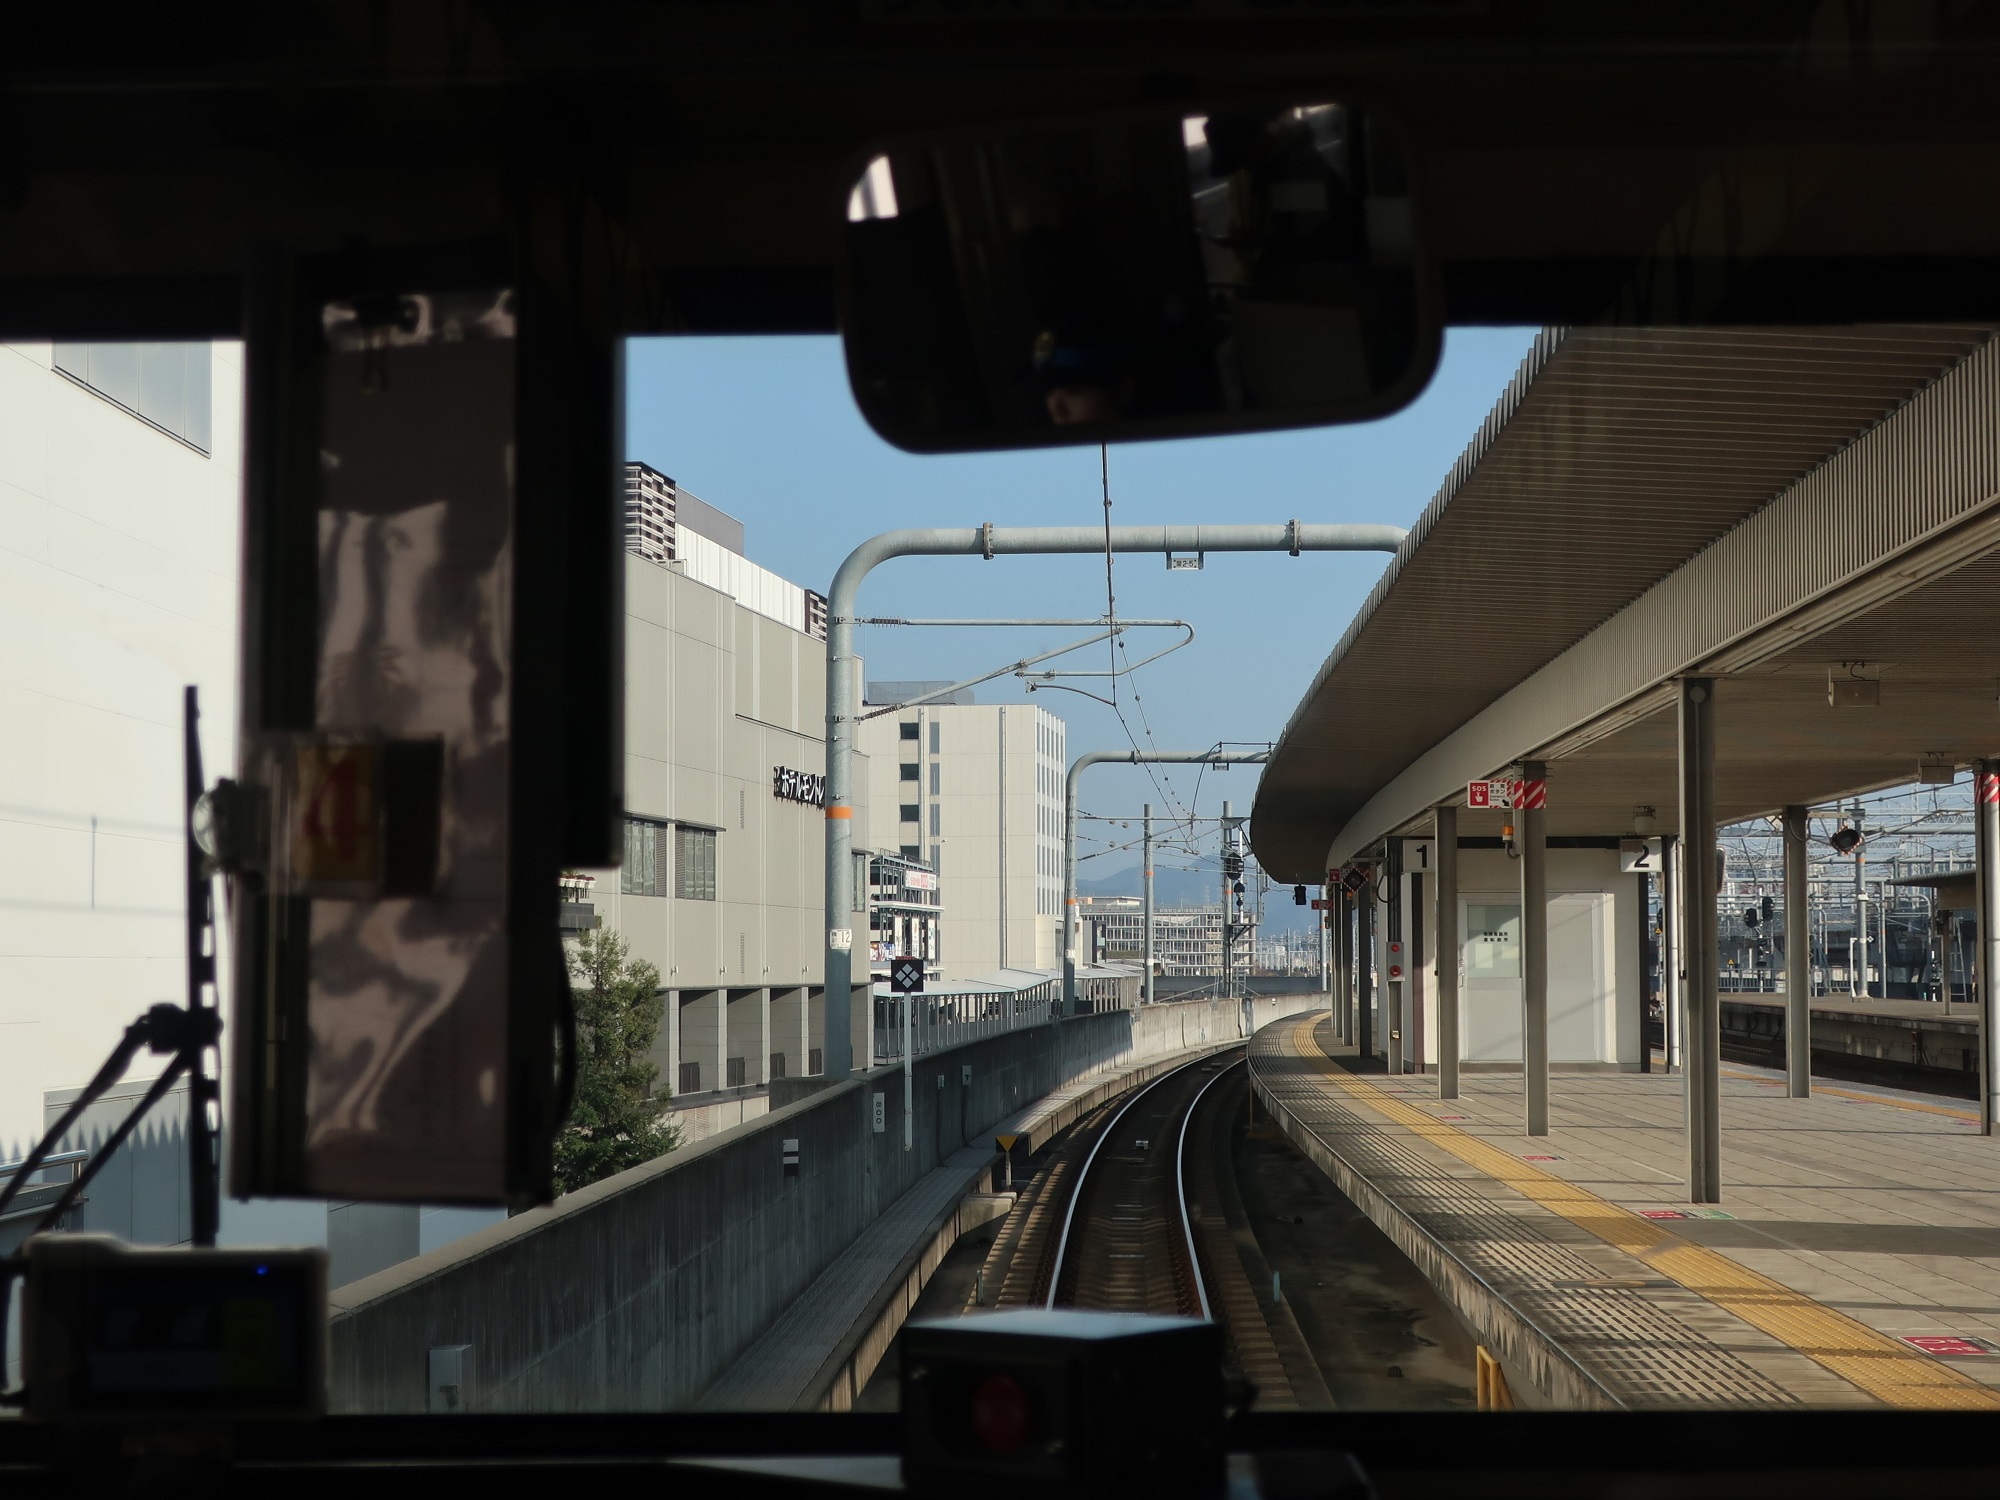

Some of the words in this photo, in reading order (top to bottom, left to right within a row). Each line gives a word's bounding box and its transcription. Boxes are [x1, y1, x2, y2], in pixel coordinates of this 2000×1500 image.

[1416, 844, 1428, 869] 1
[1634, 844, 1650, 868] 2
[841, 931, 851, 943] 12
